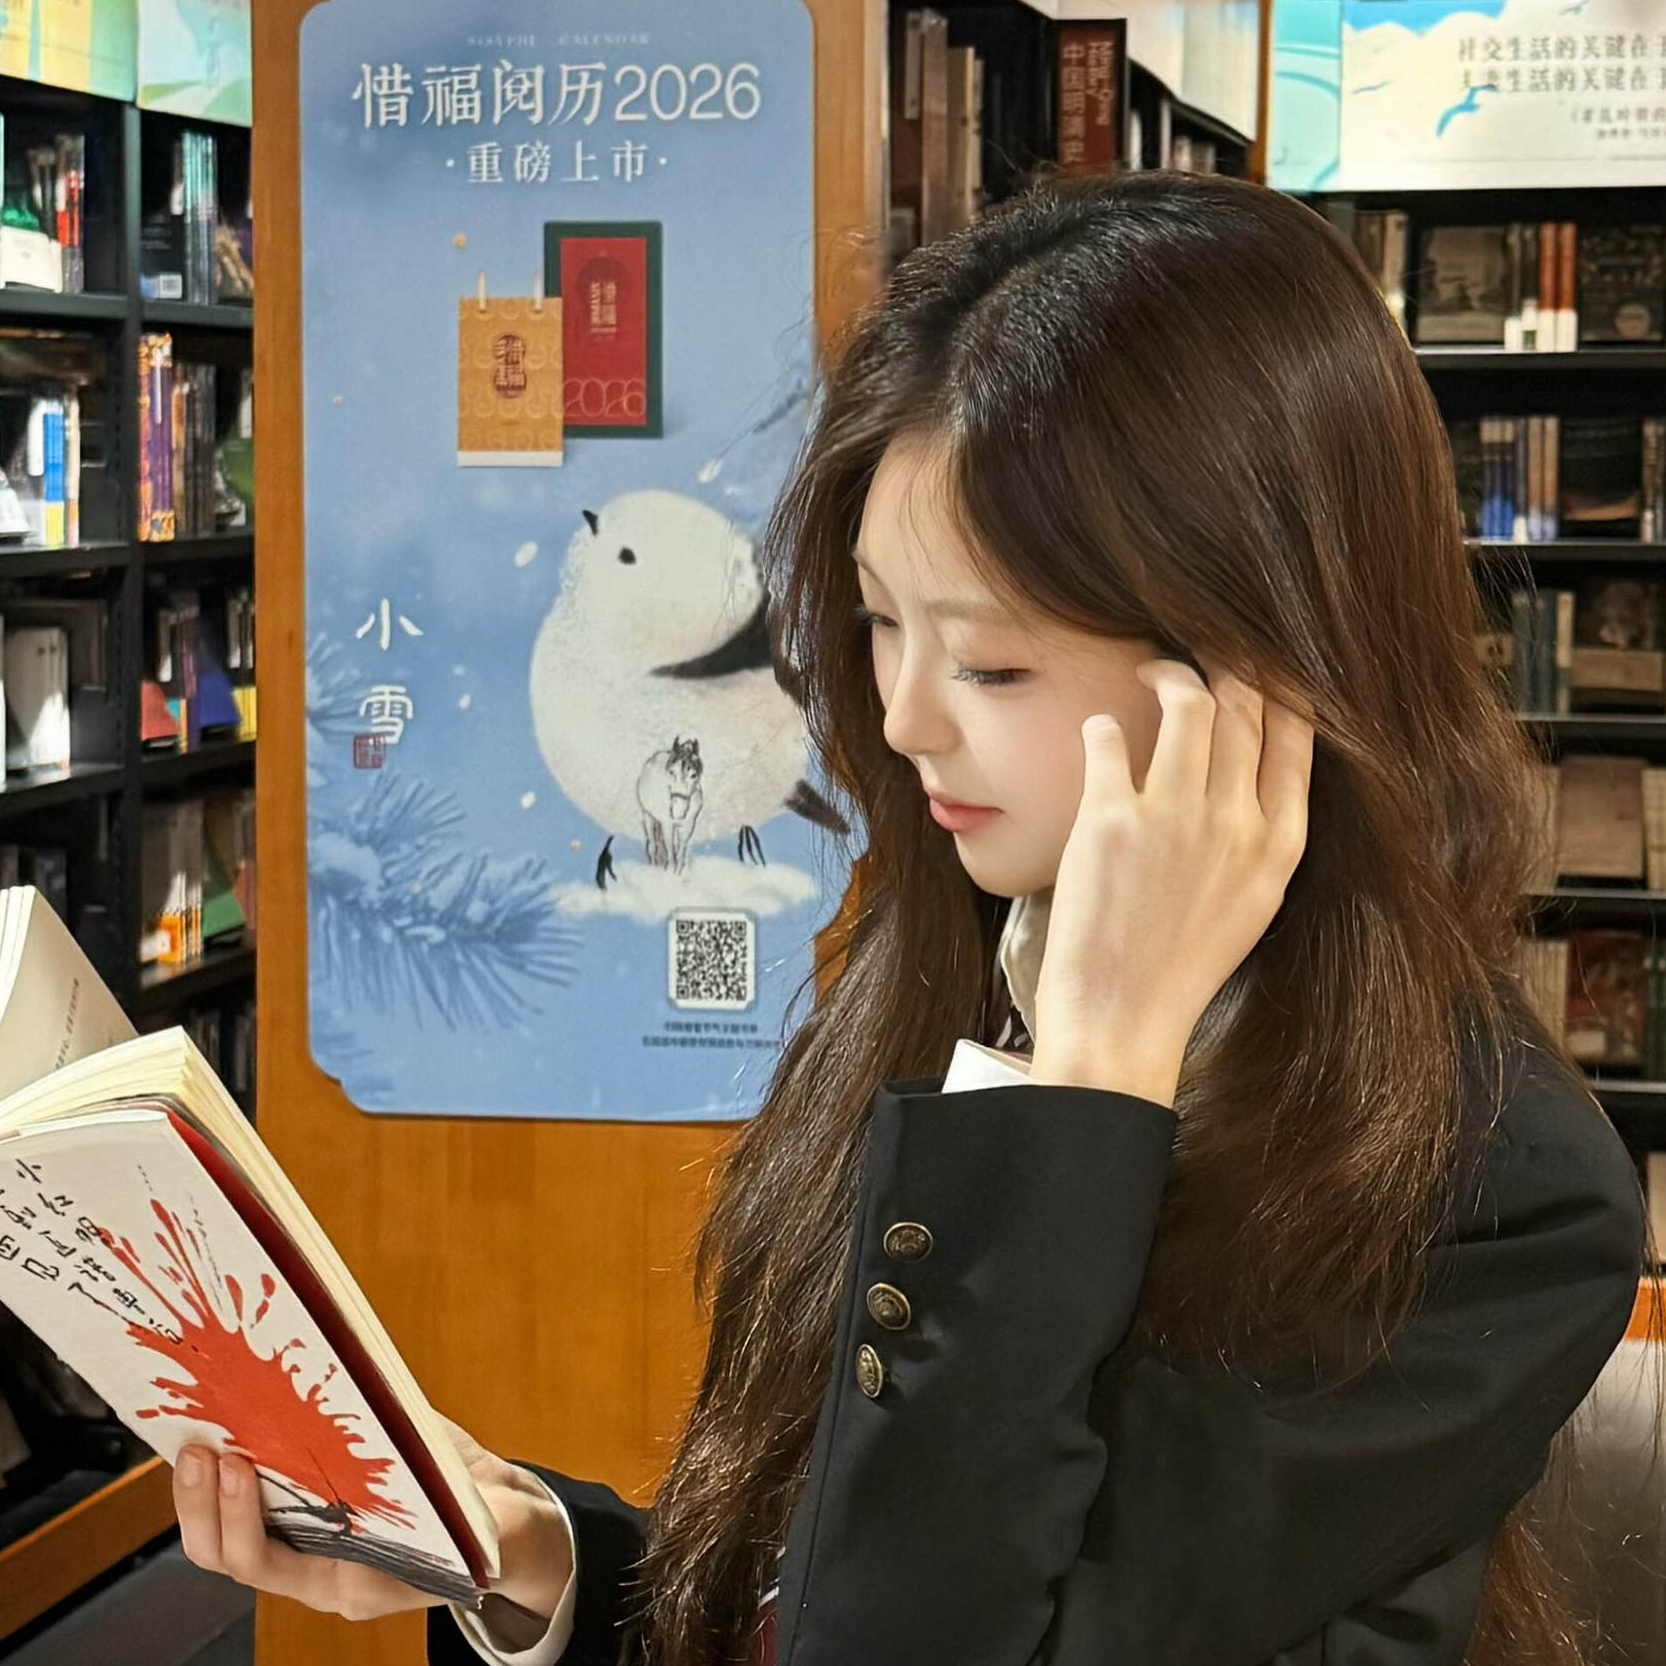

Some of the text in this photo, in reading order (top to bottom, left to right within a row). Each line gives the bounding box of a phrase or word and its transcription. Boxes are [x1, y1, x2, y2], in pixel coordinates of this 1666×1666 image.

[352, 57, 762, 130] 惜福阅历2026
[355, 598, 424, 745] 小雪
